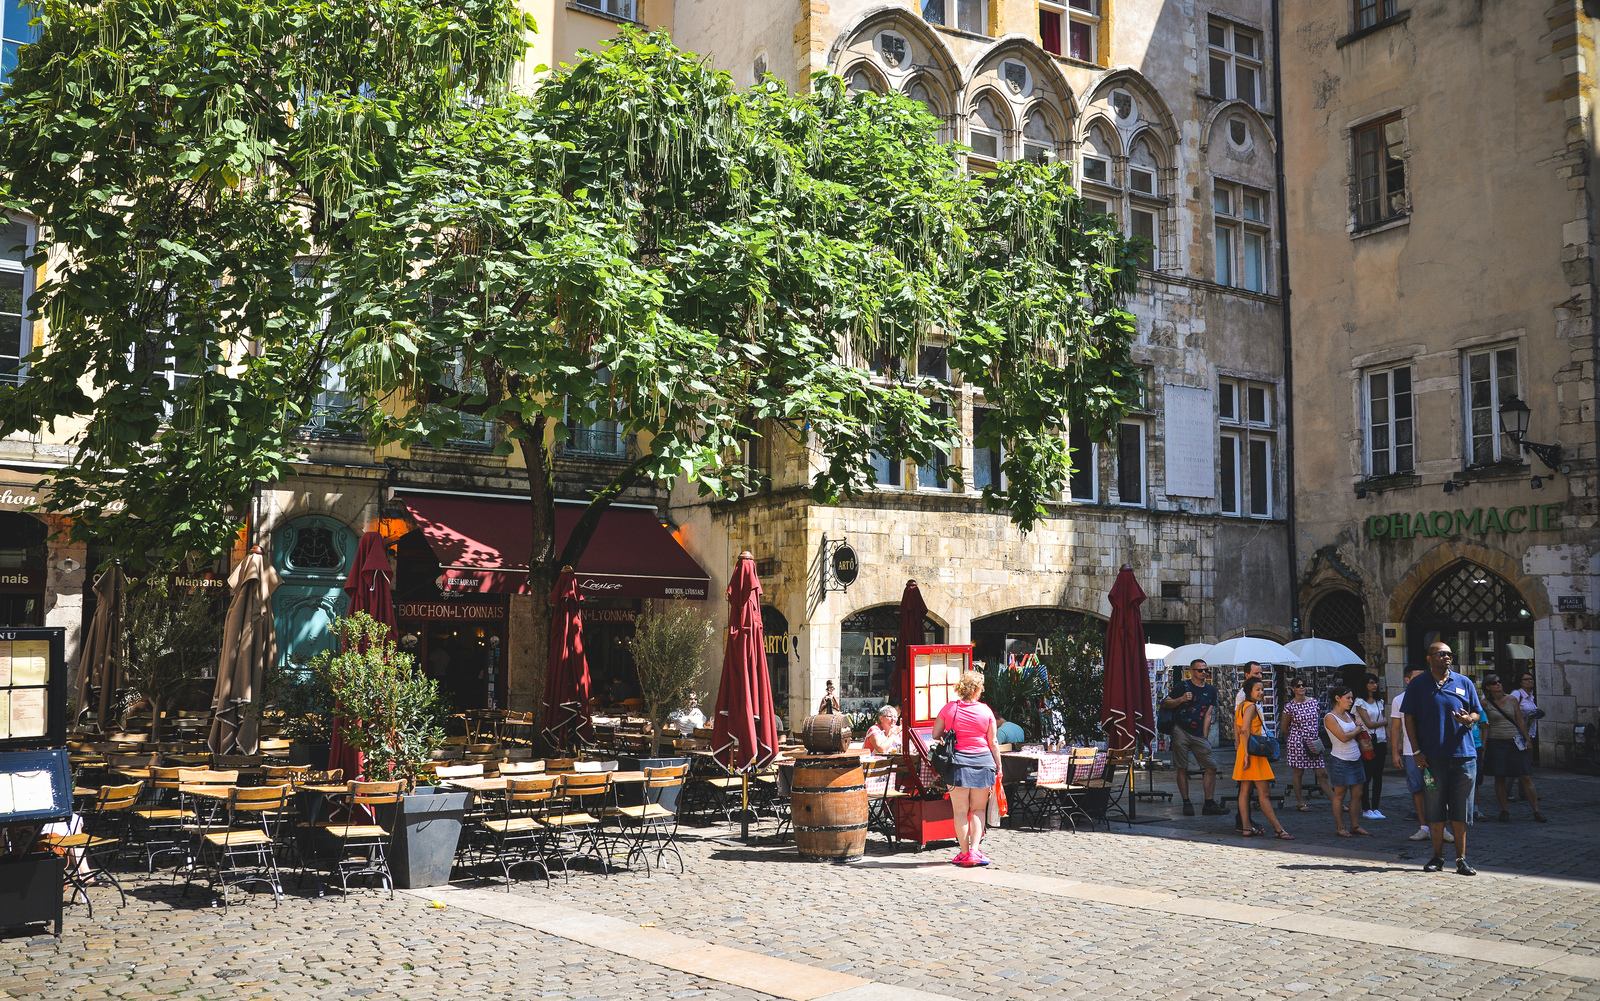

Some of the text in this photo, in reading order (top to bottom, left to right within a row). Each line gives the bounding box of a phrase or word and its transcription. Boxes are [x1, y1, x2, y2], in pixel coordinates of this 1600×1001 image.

[1367, 502, 1563, 540] PHARMACIE
[175, 576, 223, 587] Mamans
[447, 578, 479, 587] RESTAURANT
[862, 636, 897, 656] ART'
